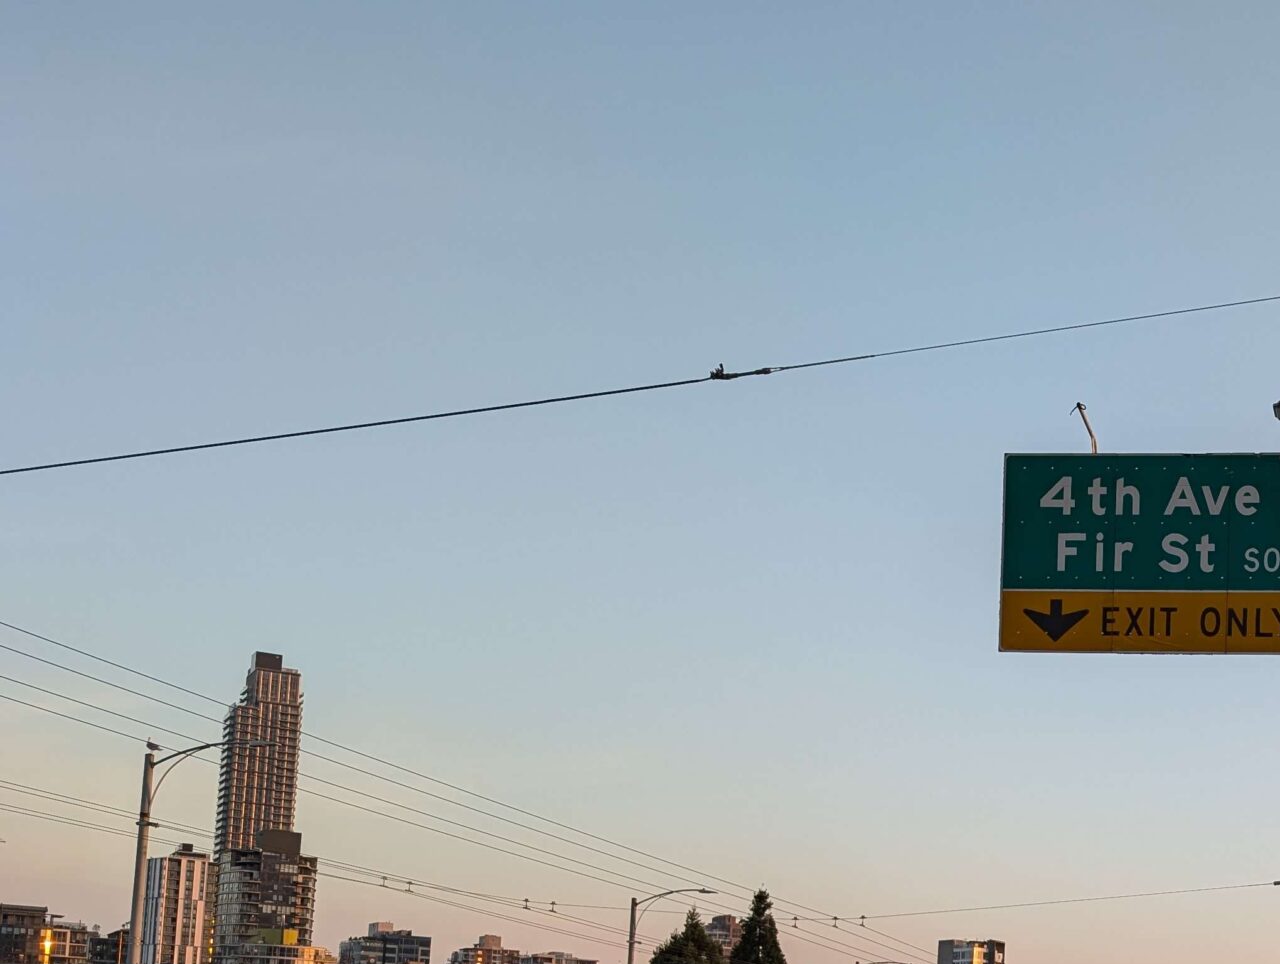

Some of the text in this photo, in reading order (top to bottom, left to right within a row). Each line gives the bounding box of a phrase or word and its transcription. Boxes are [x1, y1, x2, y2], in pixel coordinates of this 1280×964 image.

[1040, 476, 1141, 515] 4th
[1164, 476, 1261, 516] Ave
[1056, 532, 1134, 572] Fir
[1159, 533, 1216, 573] St
[1102, 607, 1178, 637] EXIT
